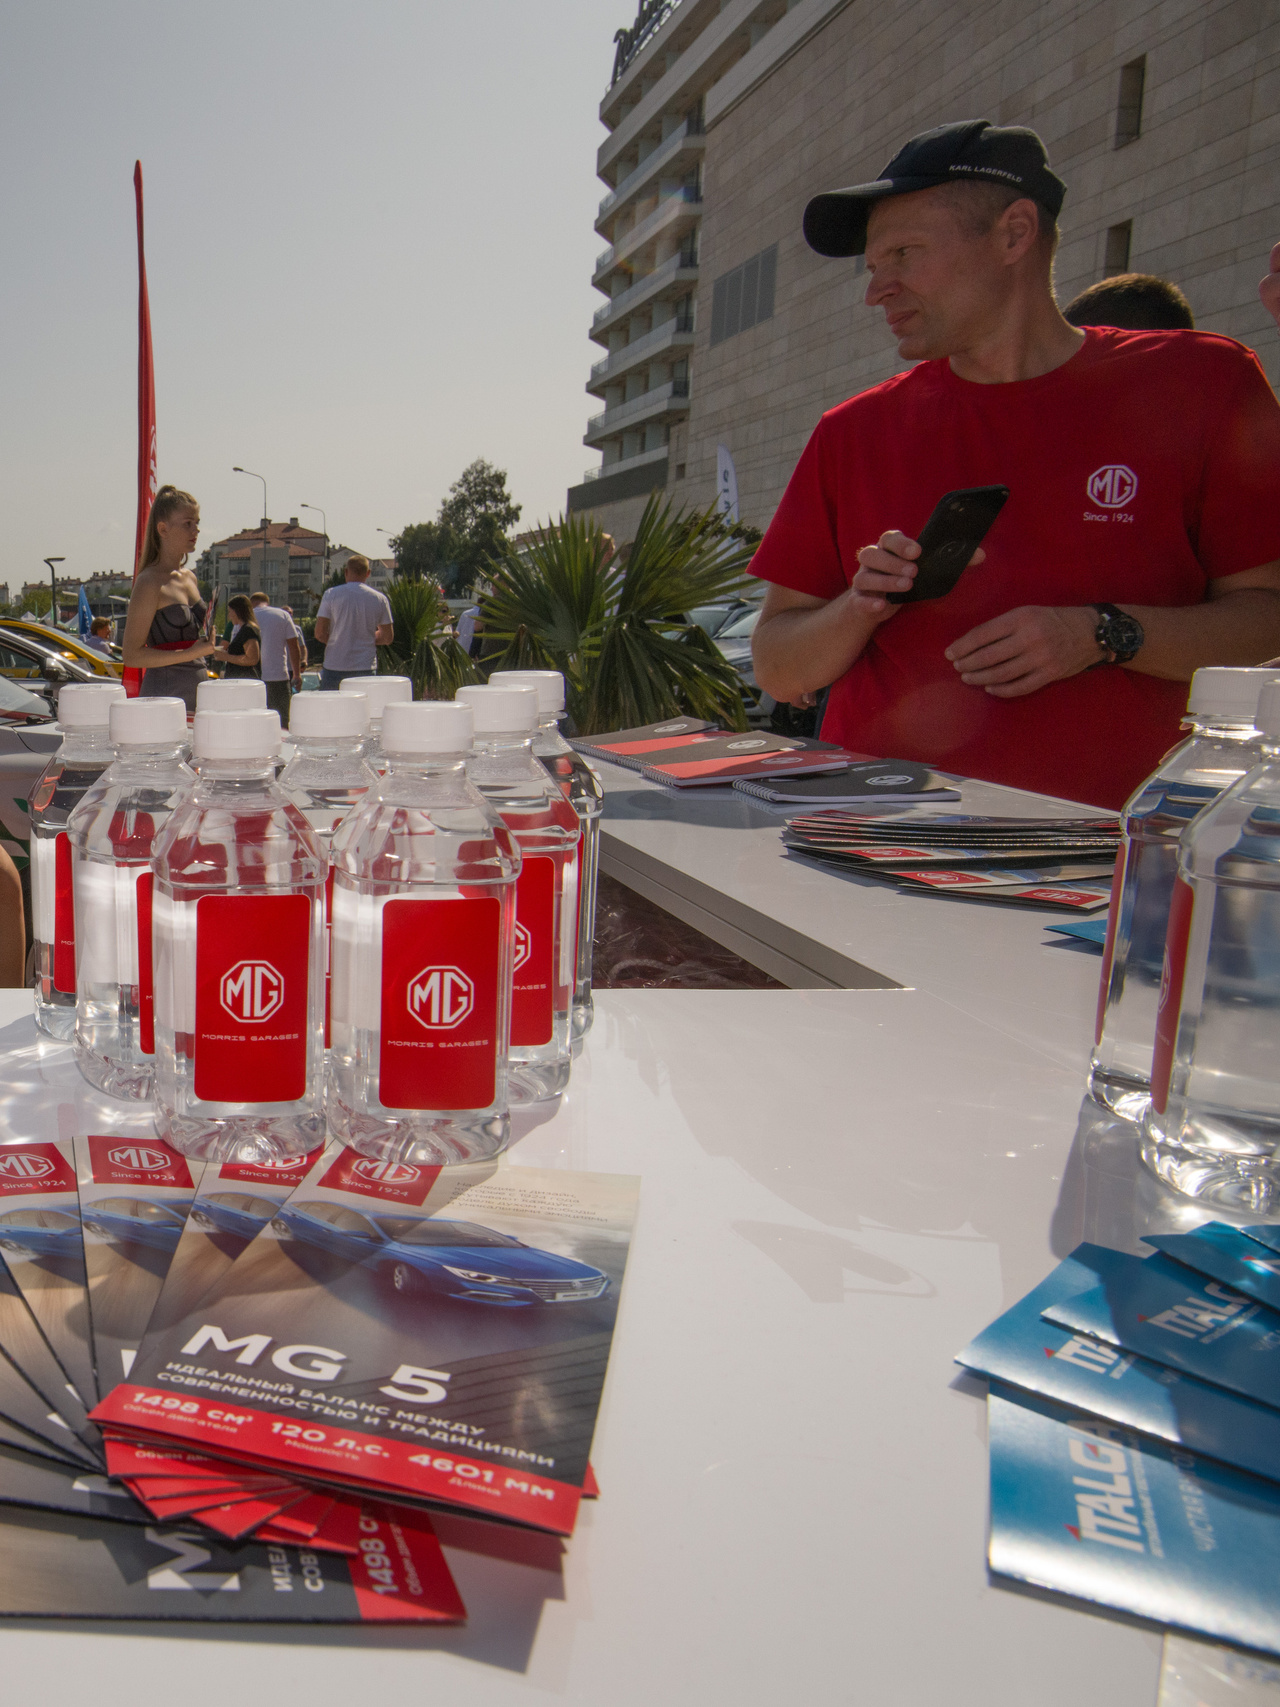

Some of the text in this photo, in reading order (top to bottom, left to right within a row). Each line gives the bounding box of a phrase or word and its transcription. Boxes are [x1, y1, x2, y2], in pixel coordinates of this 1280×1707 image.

[949, 164, 1023, 183] KARL LAGERFELD
[1093, 469, 1132, 504] MG
[1083, 511, 1135, 523] Since 1924
[226, 966, 279, 1018] MG
[413, 971, 469, 1024] MG
[201, 1033, 299, 1041] MORRIS GARAGES
[387, 1039, 489, 1048] MORRIS GARAGES
[114, 1147, 168, 1169] MG
[110, 1171, 177, 1182] Since 1924
[238, 1168, 305, 1181] Since 1924
[356, 1158, 417, 1181] MG
[1, 1179, 68, 1190] Since 1924
[340, 1177, 410, 1198] Since 1924
[179, 1323, 452, 1404] MG 5
[165, 1361, 487, 1437] ИДЕАЛЬНЫЙ БАЛАНС МЕЖДУ
[156, 1371, 556, 1469] СОВРЕМЕННОСТЬЮ И ТРАДИЦИЯМИ
[132, 1391, 201, 1416] 1498
[270, 1420, 327, 1444] 120
[407, 1453, 496, 1484] 4601
[363, 1536, 400, 1596] 1498
